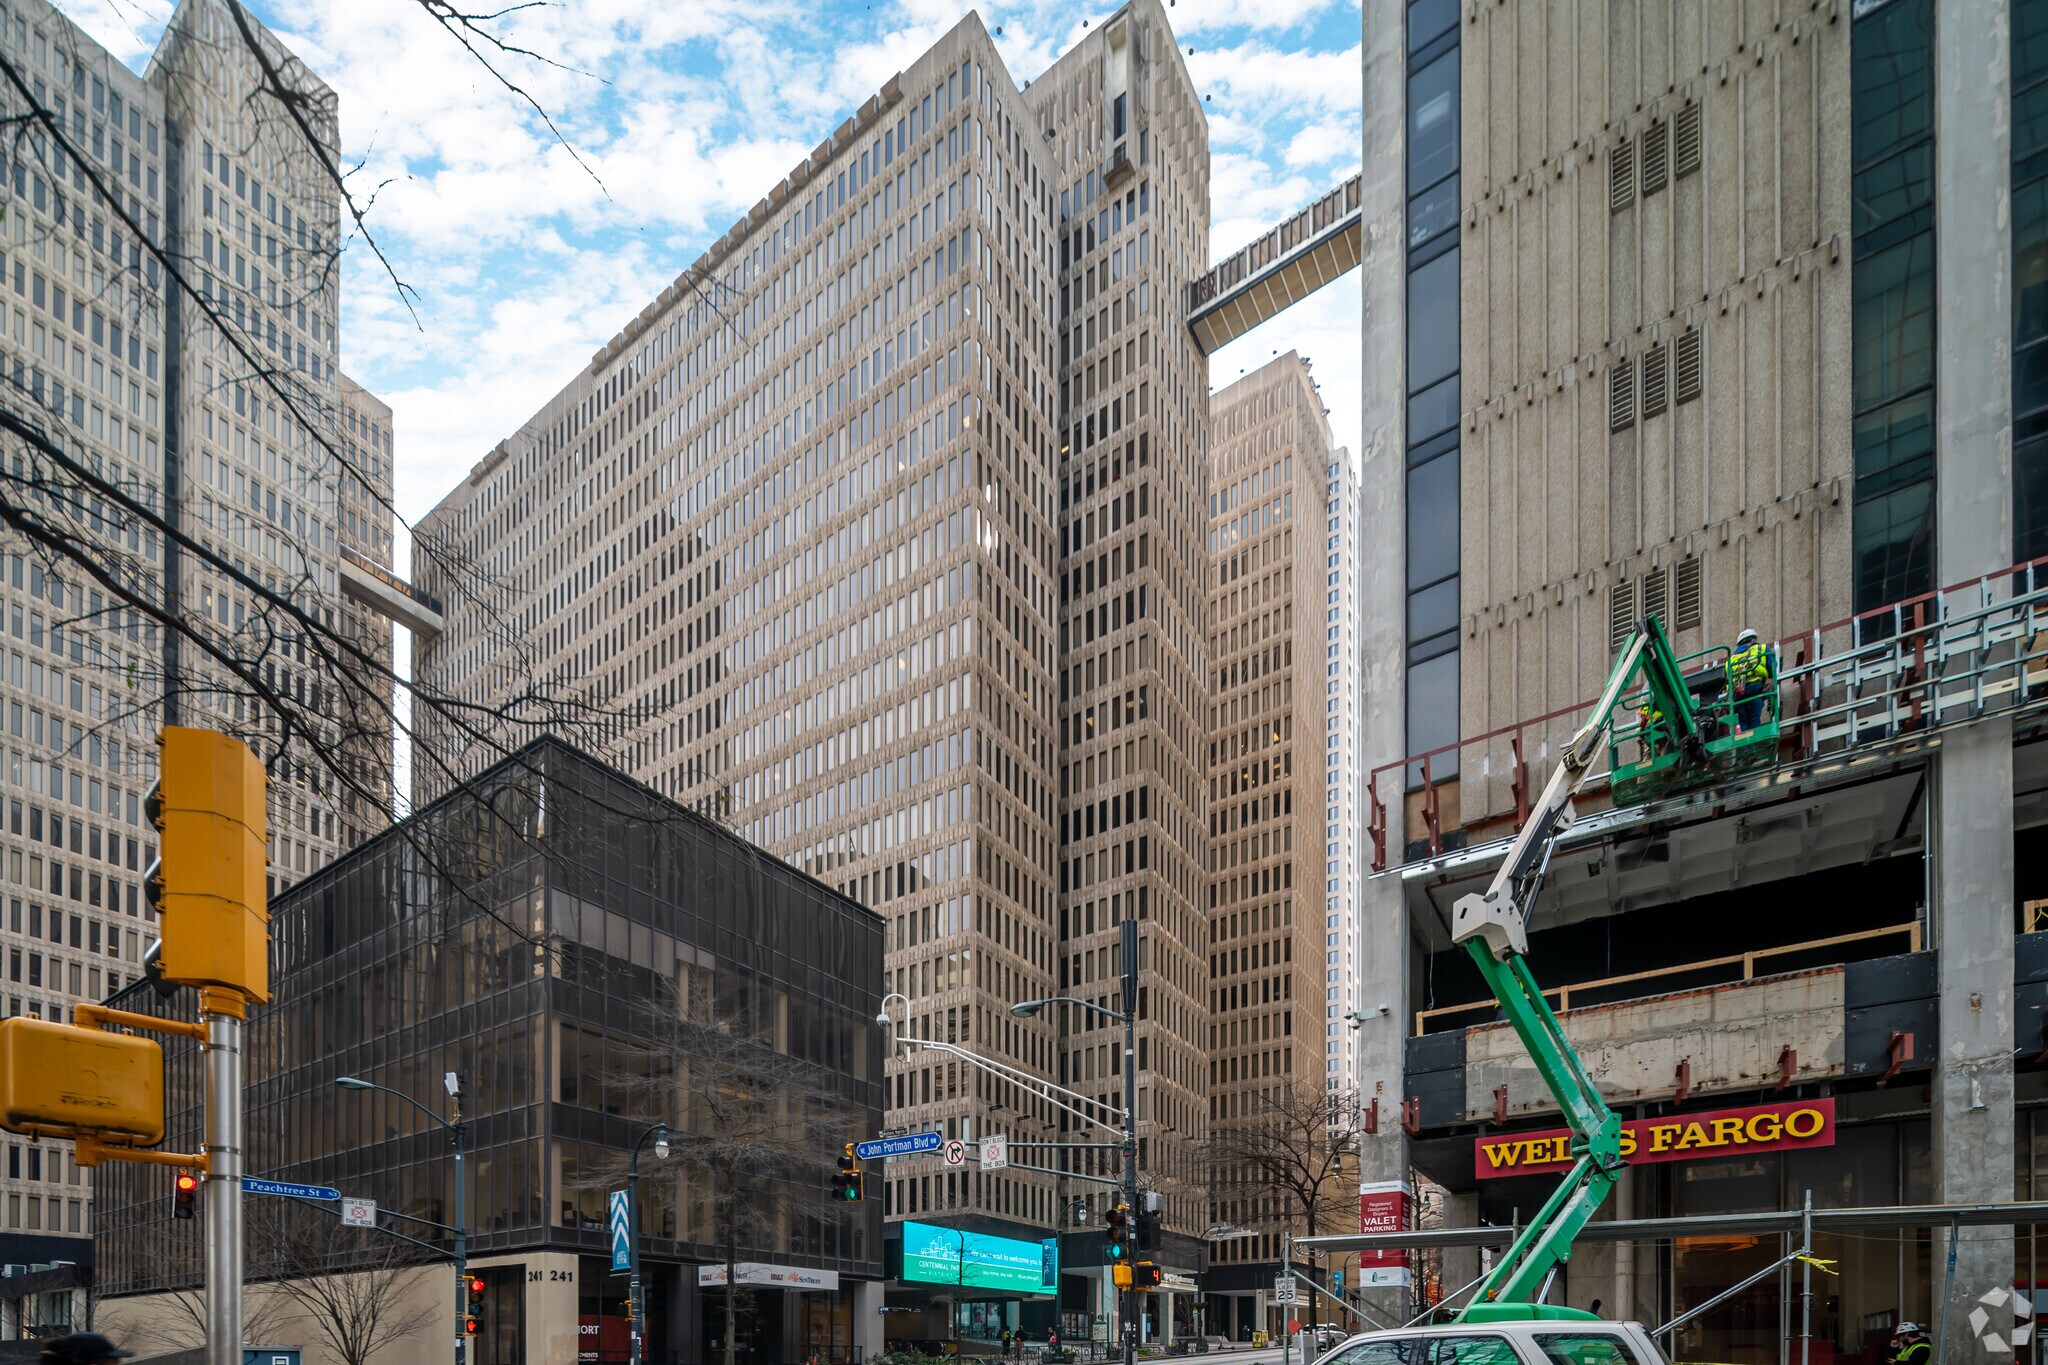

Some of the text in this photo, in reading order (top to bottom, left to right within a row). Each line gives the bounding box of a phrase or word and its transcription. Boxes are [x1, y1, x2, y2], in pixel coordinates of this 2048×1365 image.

[992, 1136, 1004, 1144] BLOCK
[1482, 1109, 1825, 1168] WELS FARGO
[867, 1144, 882, 1156] John
[884, 1142, 912, 1153] Portman
[914, 1136, 928, 1148] Blvd
[250, 1182, 306, 1196] Peachtree
[308, 1188, 320, 1196] St
[1364, 1216, 1396, 1226] VALET
[918, 1260, 949, 1270] CENTENNIAL
[1010, 1255, 1028, 1264] welcome
[528, 1270, 542, 1282] 241
[550, 1270, 572, 1282] 241
[1153, 1270, 1158, 1282] 4
[1278, 1290, 1294, 1300] 25
